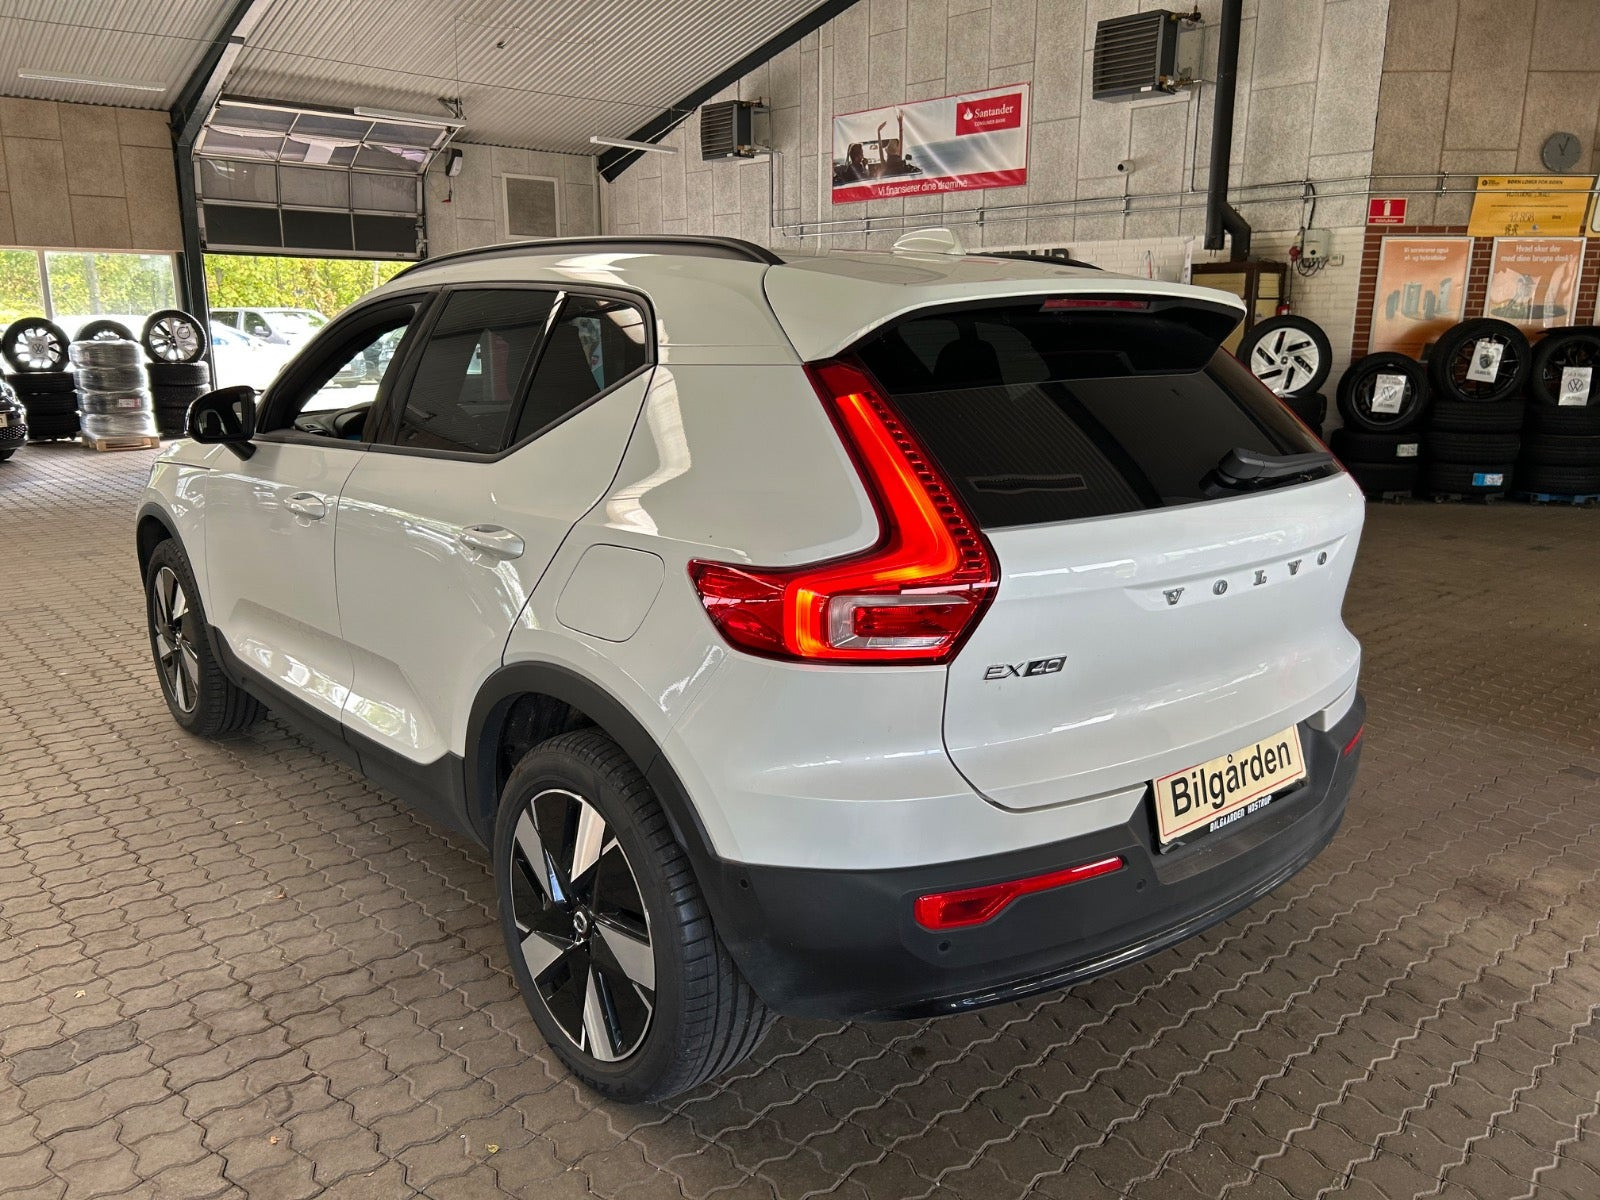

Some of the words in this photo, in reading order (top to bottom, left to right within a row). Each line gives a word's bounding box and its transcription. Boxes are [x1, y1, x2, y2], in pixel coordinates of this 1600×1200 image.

[974, 103, 1014, 118] Santander
[878, 187, 885, 196] Vi
[885, 183, 920, 196] finansierer
[921, 181, 937, 191] dine
[1515, 244, 1534, 253] Hvad
[1534, 244, 1549, 253] sker
[1501, 254, 1516, 262] med
[1532, 254, 1554, 264] brugte
[1163, 551, 1327, 605] VOLVO
[983, 656, 1067, 680] EX40
[1170, 741, 1292, 817] Bilgården
[1210, 807, 1245, 833] BILGAARDEN
